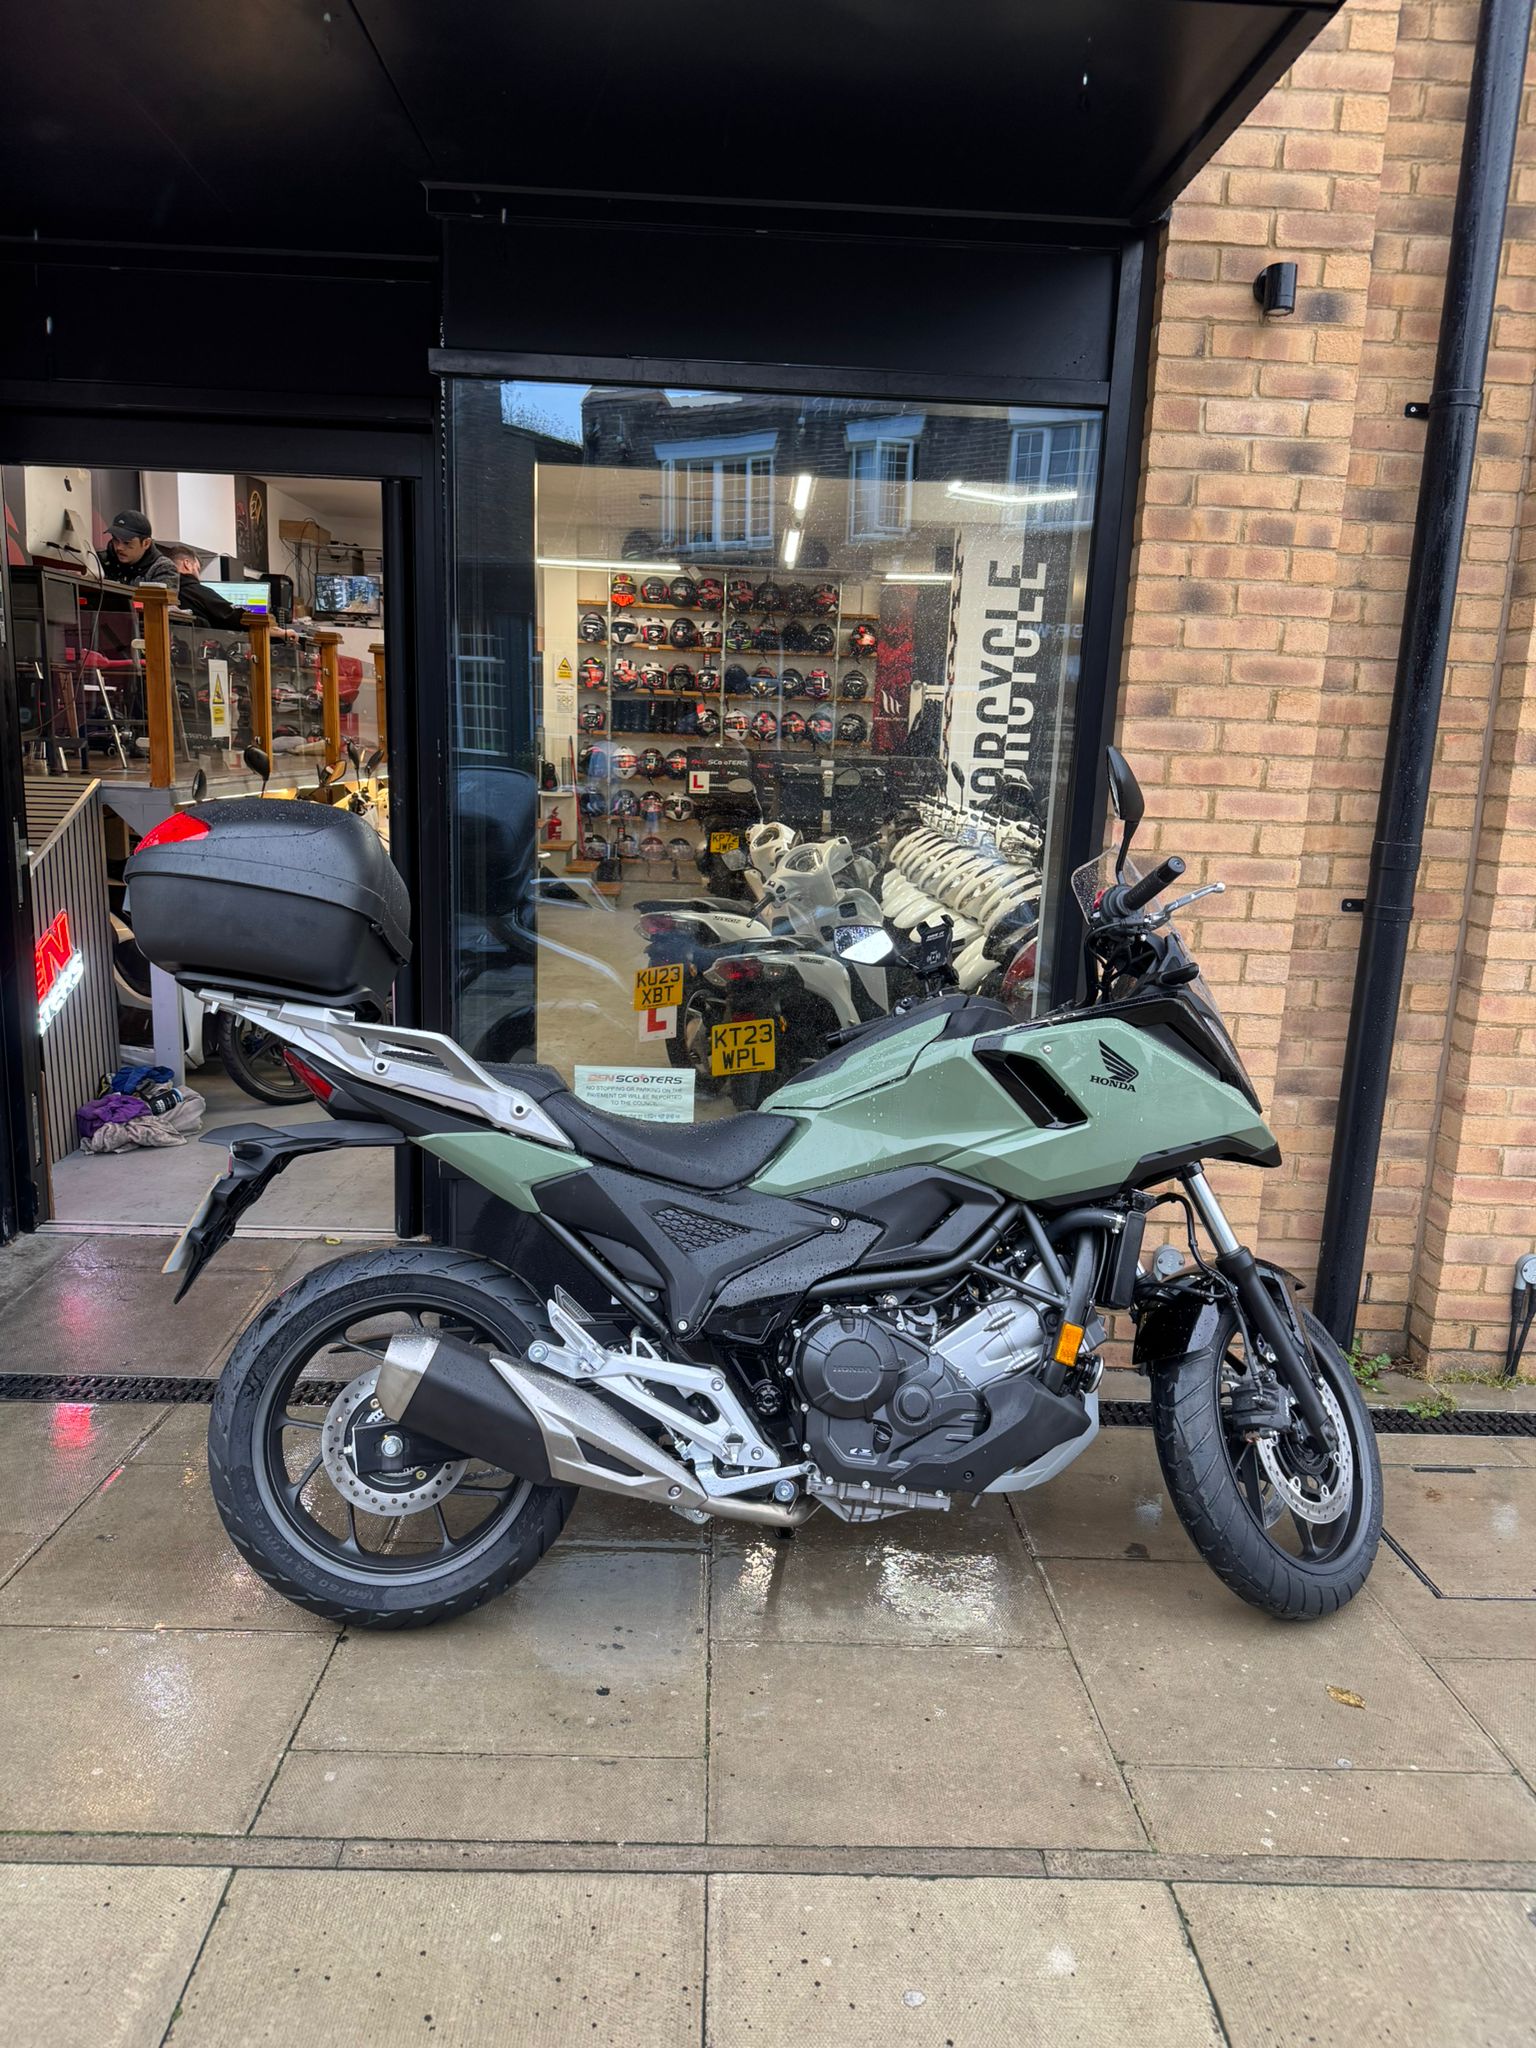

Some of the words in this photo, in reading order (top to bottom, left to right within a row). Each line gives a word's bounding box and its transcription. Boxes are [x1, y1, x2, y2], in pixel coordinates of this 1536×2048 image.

[968, 560, 1047, 806] ORCYCLE
[693, 774, 704, 789] L
[637, 966, 680, 988] KU23
[642, 985, 674, 1005] XBT
[647, 1008, 667, 1032] L
[714, 1023, 773, 1049] KT23
[722, 1047, 765, 1069] WPL
[1090, 1075, 1136, 1093] HONDA
[832, 1365, 873, 1373] HONDA
